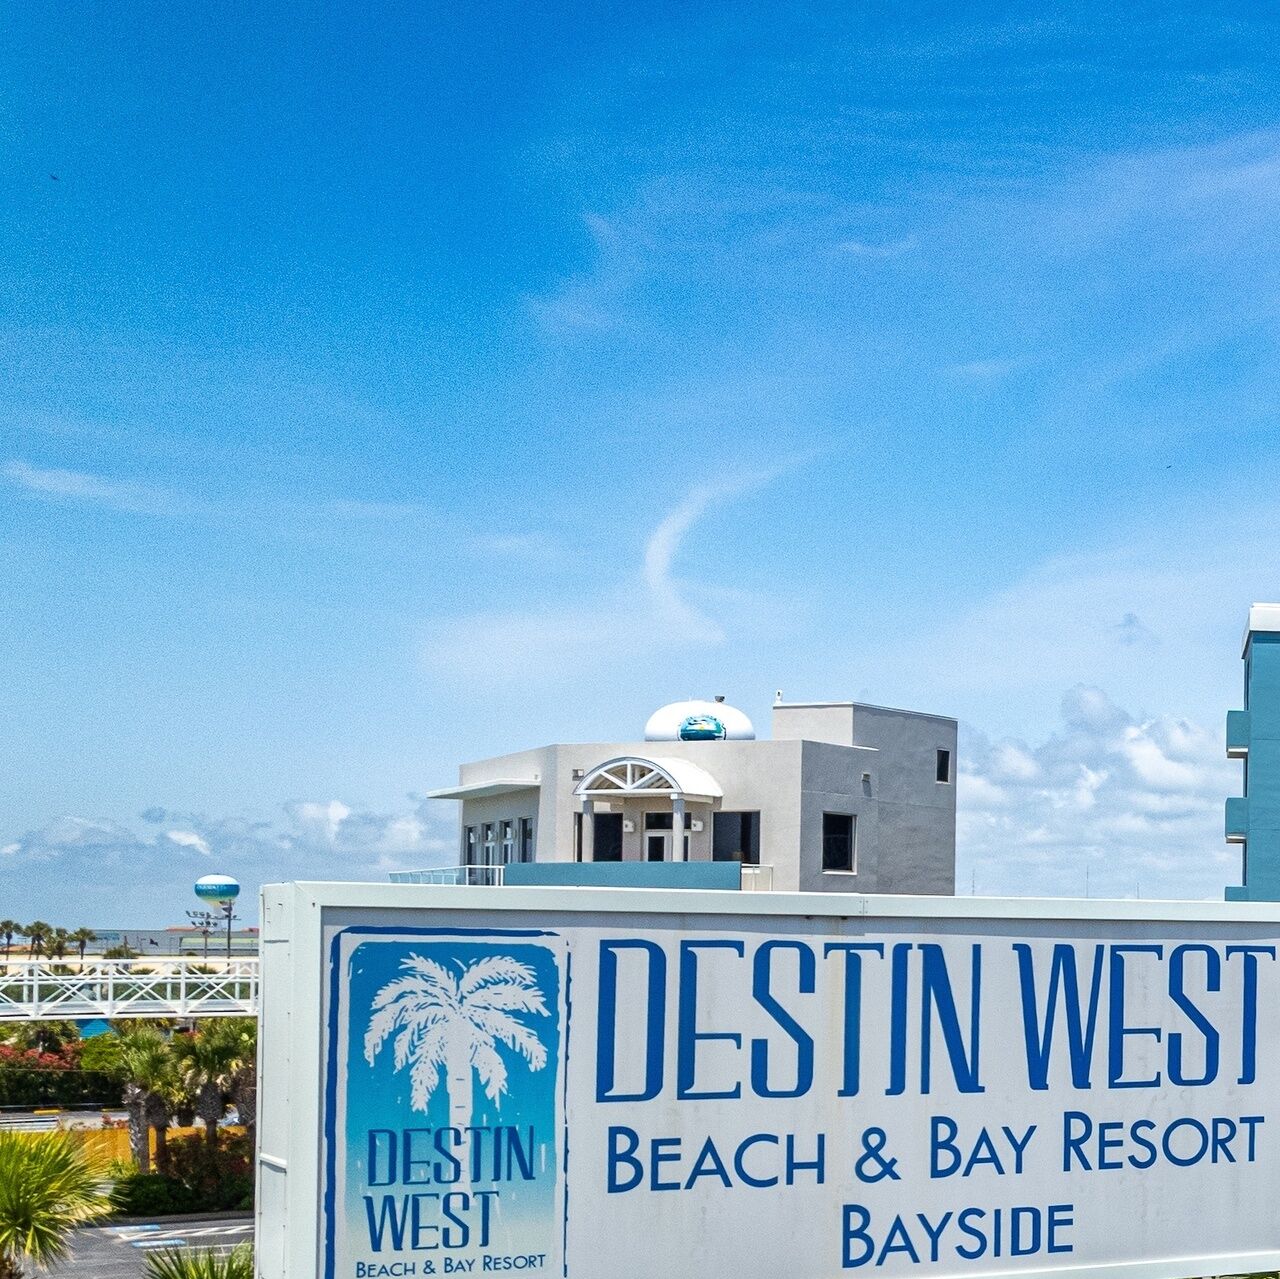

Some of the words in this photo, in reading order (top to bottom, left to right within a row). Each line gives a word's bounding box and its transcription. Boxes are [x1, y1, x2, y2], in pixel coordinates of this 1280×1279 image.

[596, 938, 985, 1103] DESTIN
[1012, 943, 1276, 1090] WEST
[366, 1125, 536, 1187] DESTIN
[607, 1126, 825, 1193] BEACH
[854, 1126, 901, 1183] &
[930, 1115, 1037, 1178] BAY
[1063, 1111, 1265, 1171] RESORT
[363, 1190, 500, 1252] WEST
[842, 1203, 1075, 1268] BAYSIDE
[355, 1260, 416, 1278] BEACH
[423, 1259, 436, 1275] &
[443, 1256, 477, 1273] BAY
[482, 1253, 547, 1271] RESORT
